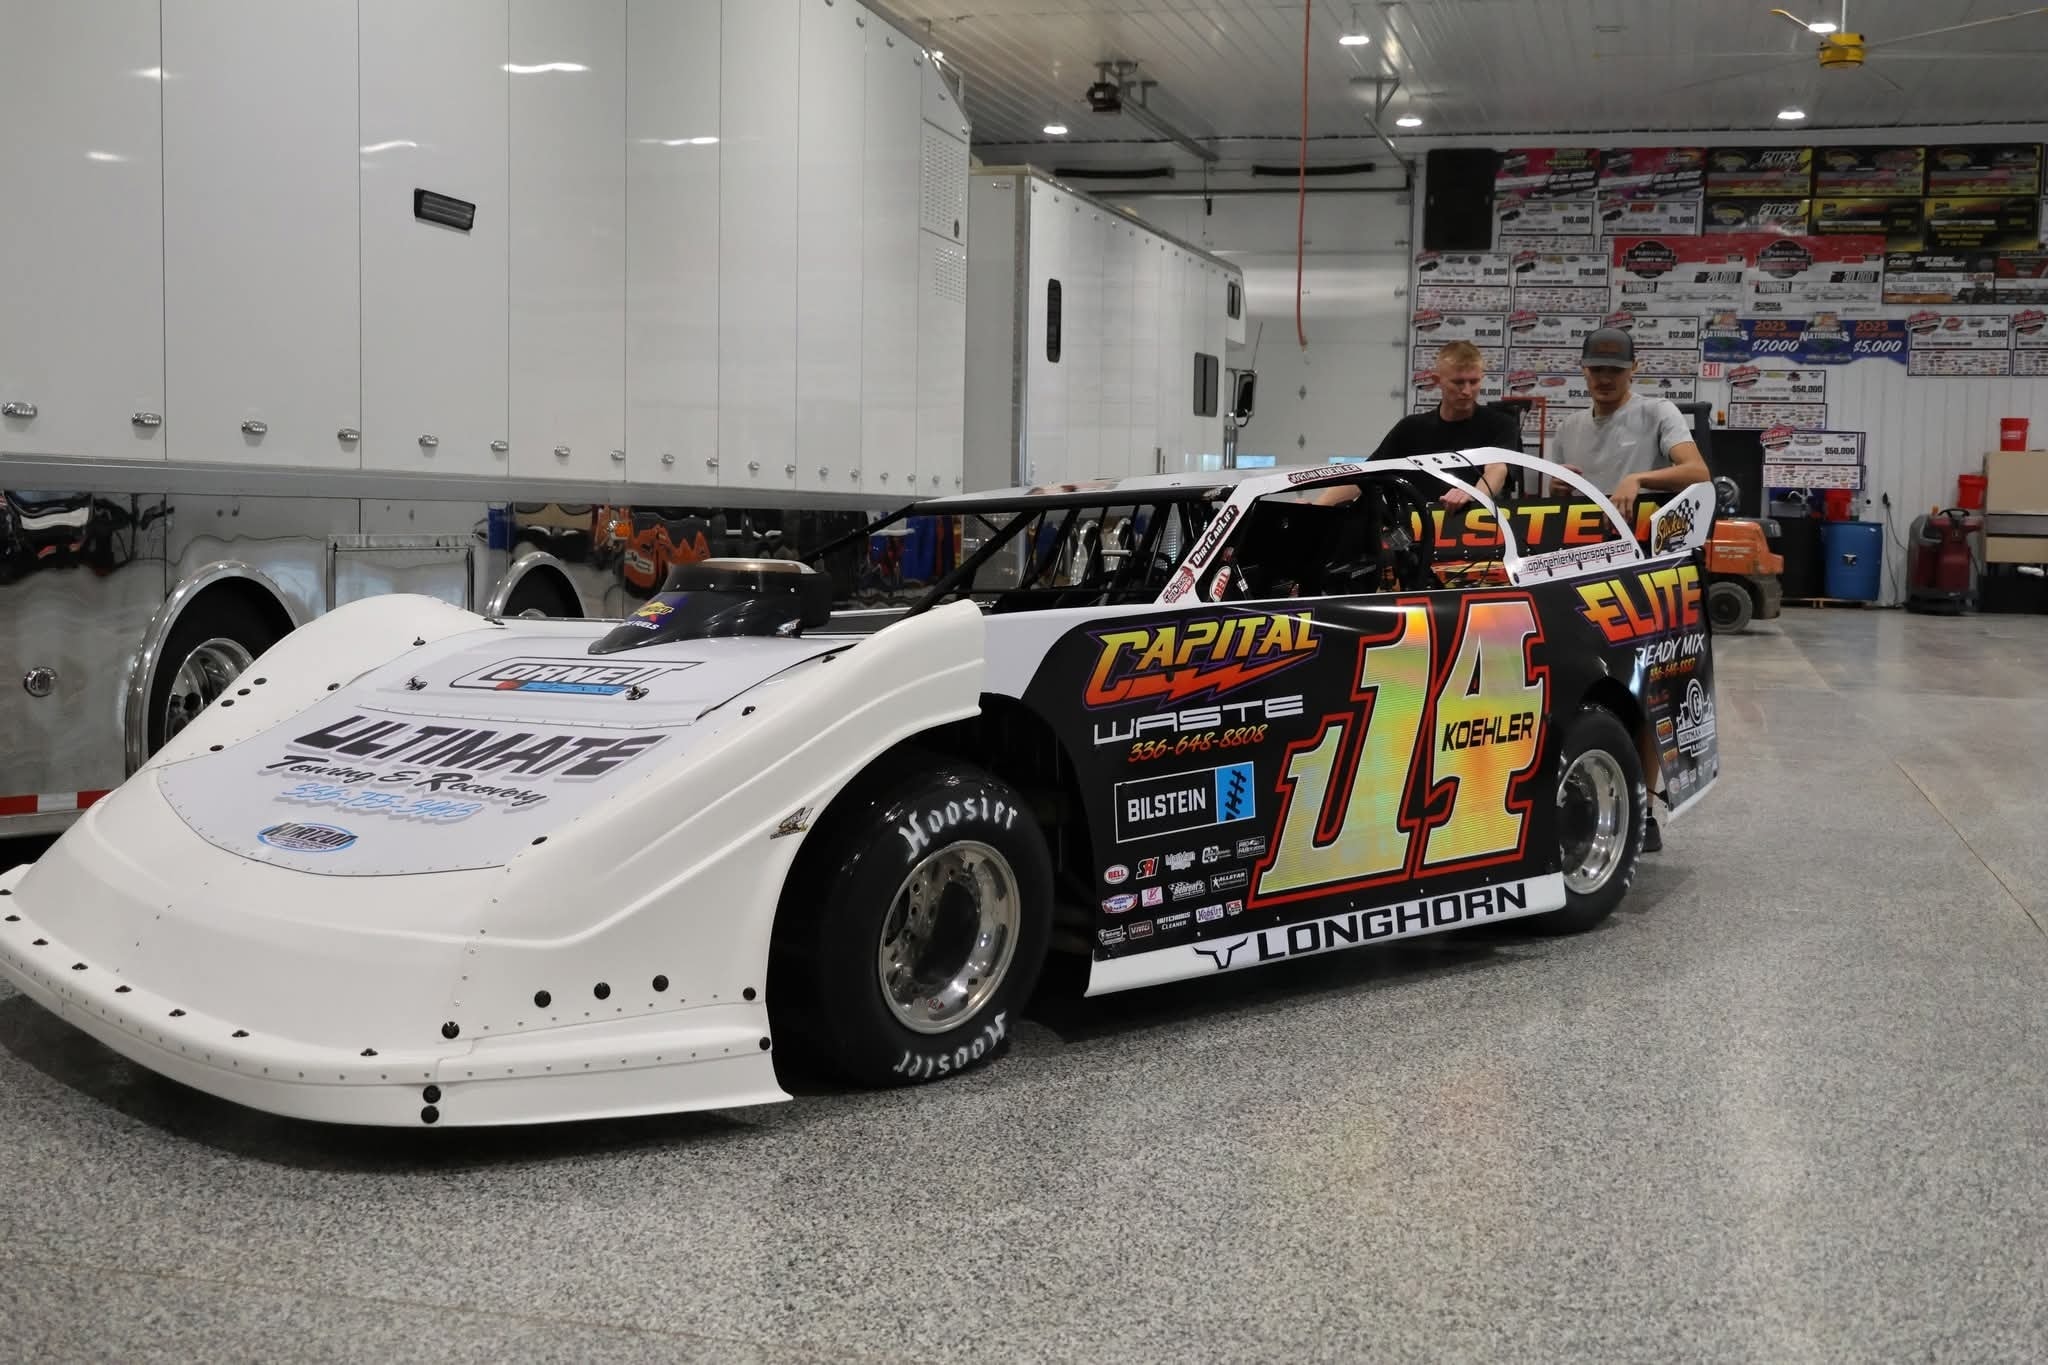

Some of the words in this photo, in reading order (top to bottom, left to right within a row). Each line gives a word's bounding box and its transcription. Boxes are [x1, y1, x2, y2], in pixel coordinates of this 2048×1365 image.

[1752, 339, 1800, 352] $7,000
[1853, 339, 1903, 353] $5,000
[1317, 464, 1359, 478] KOEHLER
[1575, 565, 1702, 642] ELITE
[1085, 612, 1320, 706] CAPITAL
[1681, 633, 1705, 657] MIX
[1094, 695, 1303, 744] WASTE
[1128, 723, 1268, 762] 336-648-8808
[1442, 711, 1534, 751] KOEHLER
[293, 715, 670, 777] ULTIMATE
[1250, 593, 1550, 906] 14
[266, 755, 374, 784] Towing
[378, 769, 419, 783] &
[414, 772, 547, 807] Recovery
[1127, 786, 1207, 823] BILSTEIN
[898, 798, 1018, 864] Hoosier
[1108, 869, 1125, 879] BELL
[1256, 882, 1528, 961] LONGHORN
[893, 1010, 1007, 1078] Hoosier
